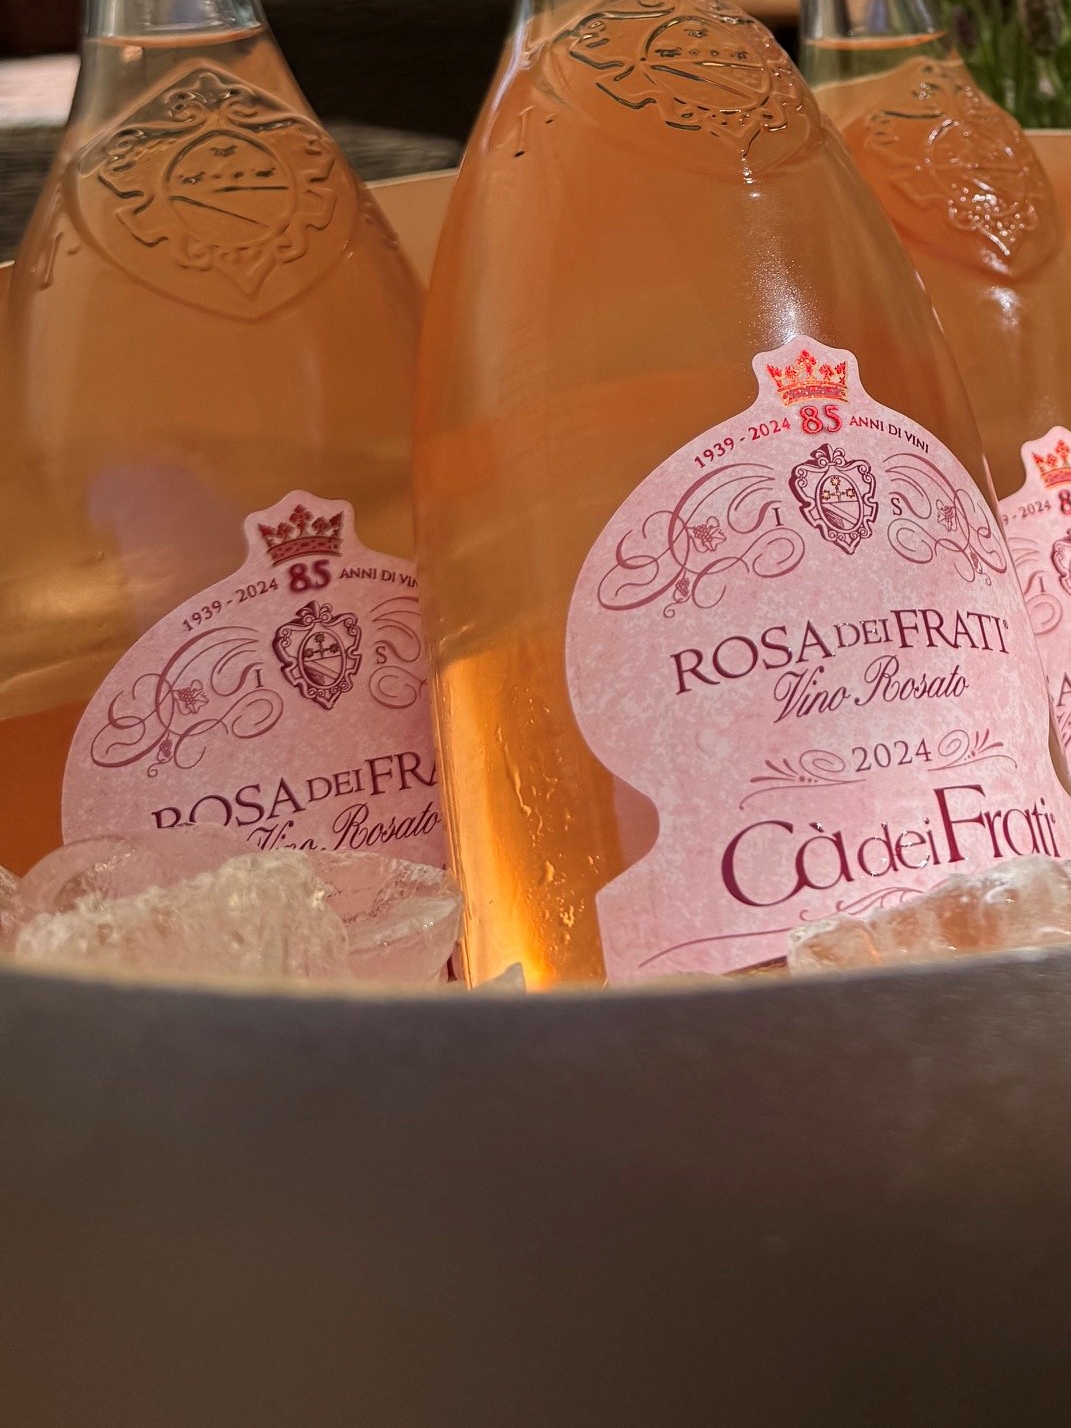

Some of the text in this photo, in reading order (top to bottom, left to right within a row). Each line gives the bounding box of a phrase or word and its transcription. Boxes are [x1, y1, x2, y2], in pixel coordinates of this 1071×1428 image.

[693, 437, 735, 468] 1939
[748, 417, 792, 441] 2024
[799, 404, 843, 435] 85
[849, 415, 885, 432] ANNI
[888, 424, 902, 439] DI
[904, 433, 930, 454] VINI
[891, 497, 903, 516] S
[182, 599, 222, 632] 1939
[235, 577, 279, 604] 2024
[286, 559, 333, 594] 85
[339, 566, 377, 580] ANNI
[381, 570, 395, 584] DI
[376, 645, 387, 665] S
[670, 619, 836, 695] ROSA
[833, 618, 893, 649] DEI
[773, 655, 969, 724] Vino Rosato
[852, 737, 933, 773] 2024
[306, 768, 365, 803] DEI
[319, 800, 442, 851] Rosato
[721, 819, 855, 908] Cà
[857, 817, 941, 878] dei
